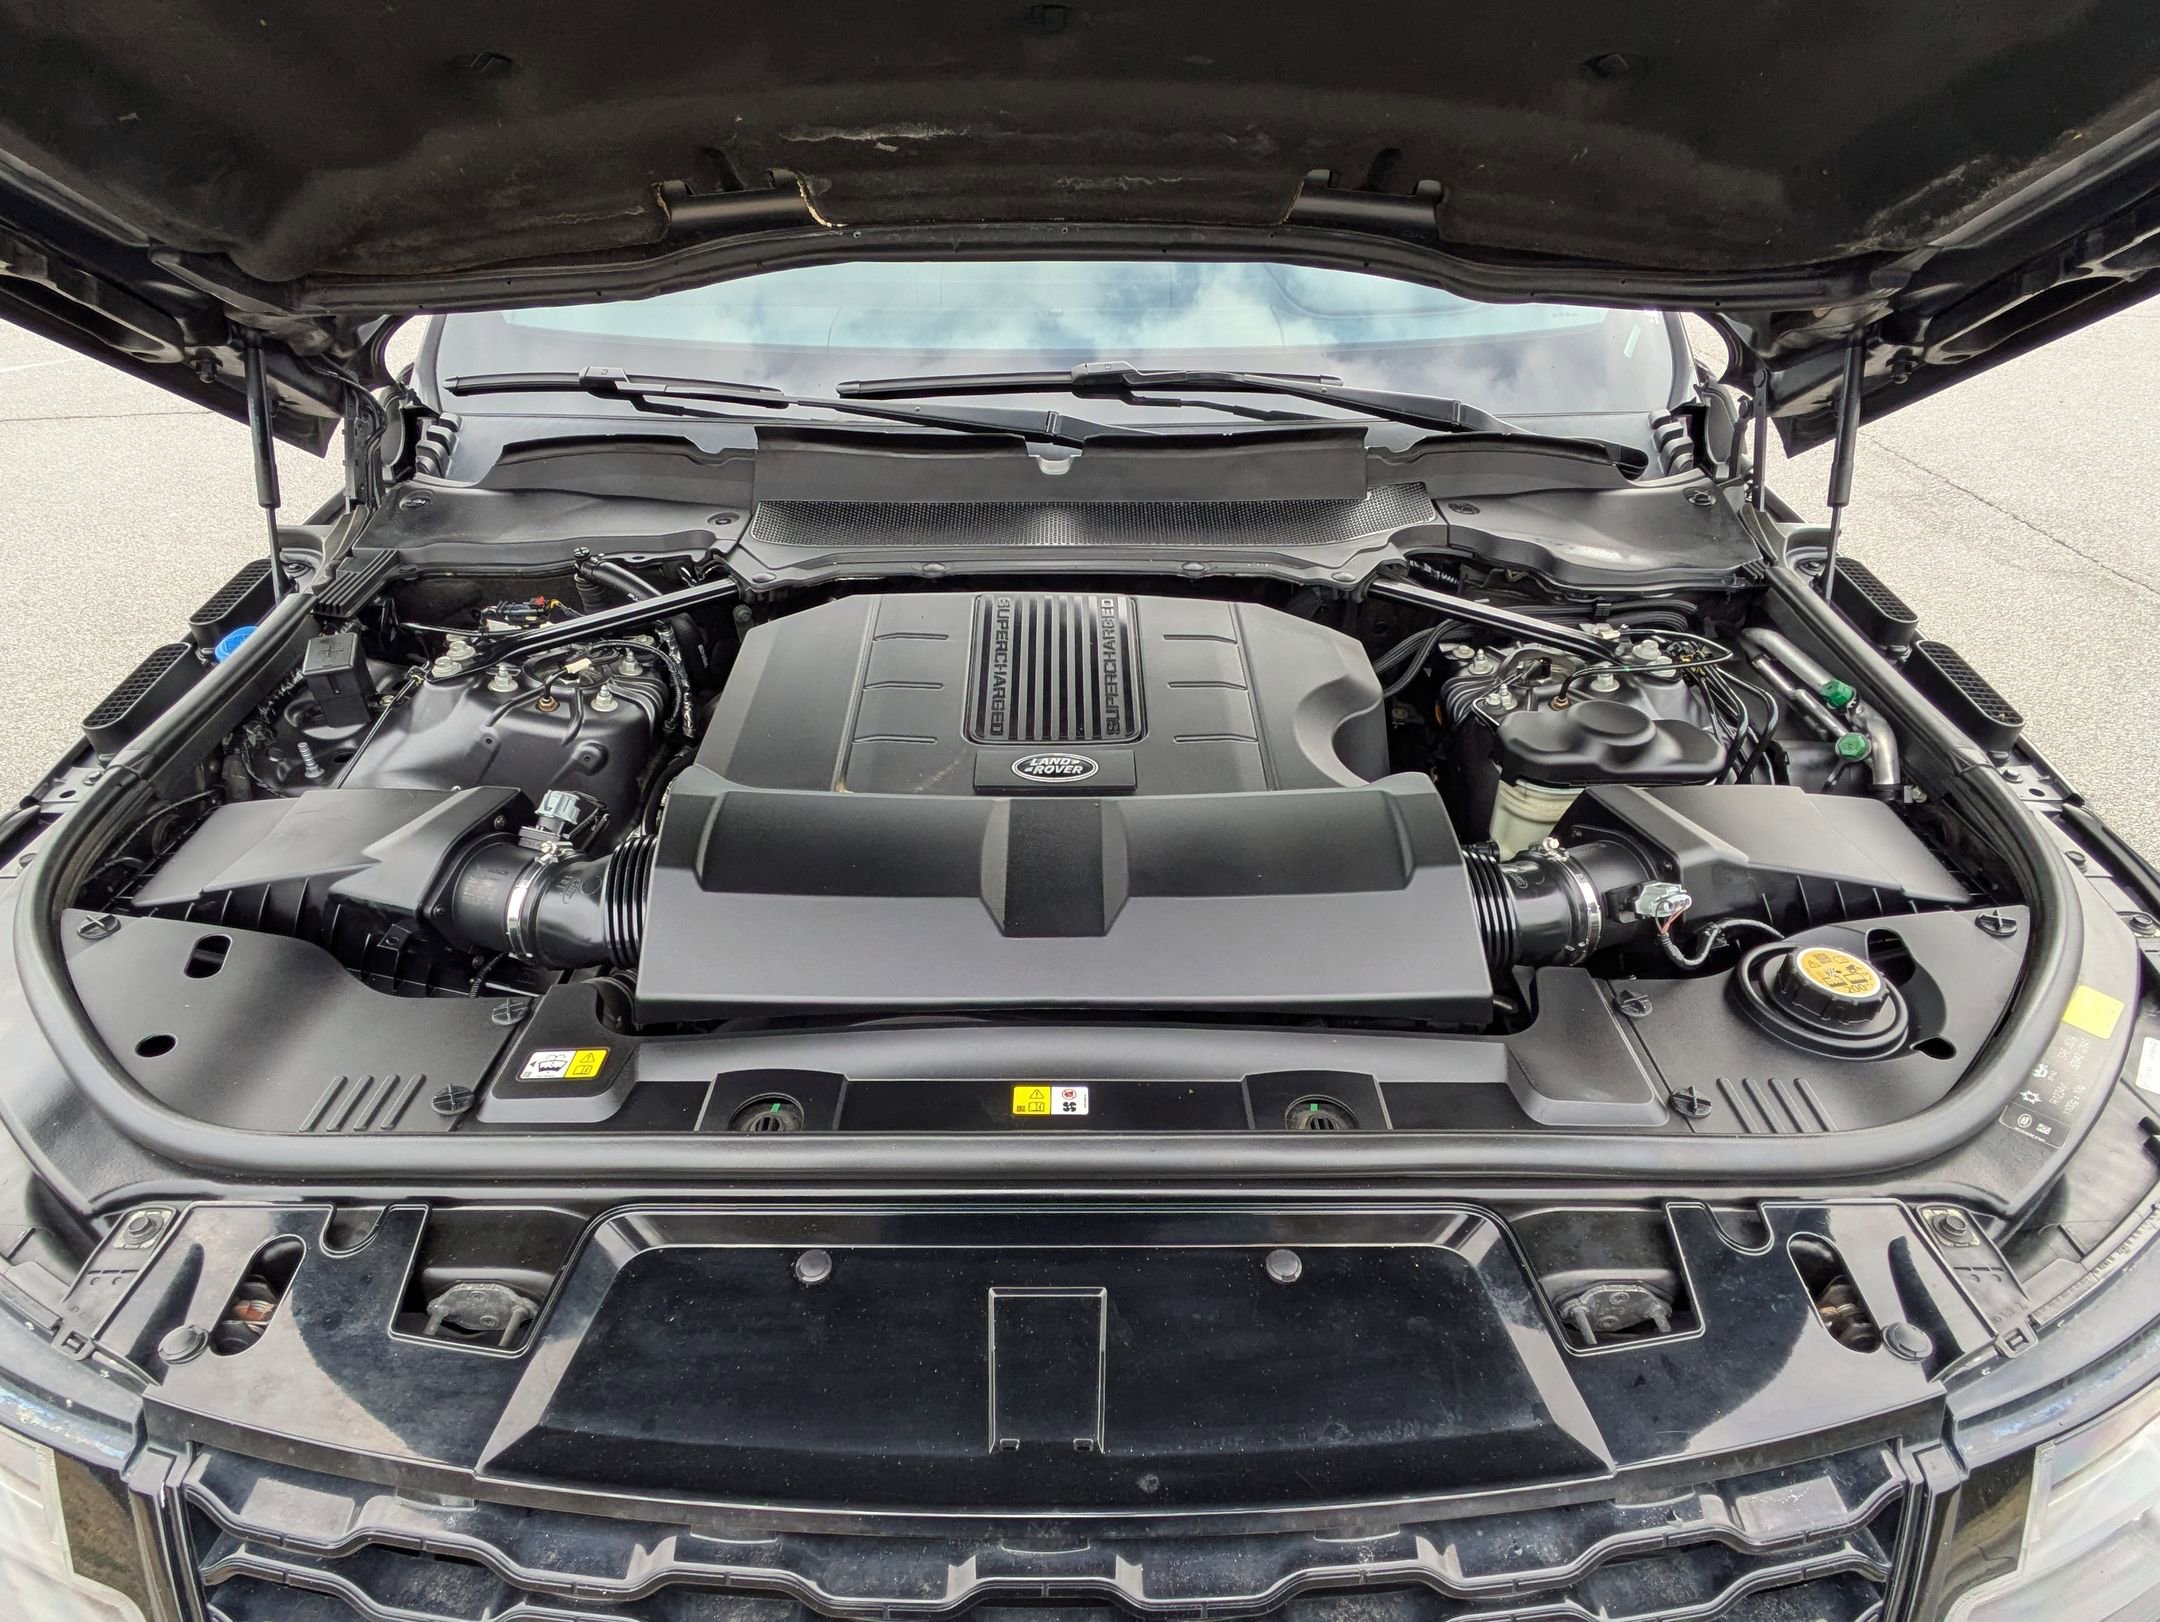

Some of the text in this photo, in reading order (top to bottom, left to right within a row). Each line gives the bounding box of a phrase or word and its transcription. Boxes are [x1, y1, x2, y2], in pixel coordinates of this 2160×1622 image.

[990, 597, 1010, 736] SUPERCHARGED
[1101, 599, 1121, 736] SUPERCHARGED
[1030, 757, 1071, 766] LAND
[1032, 765, 1084, 775] ROVER
